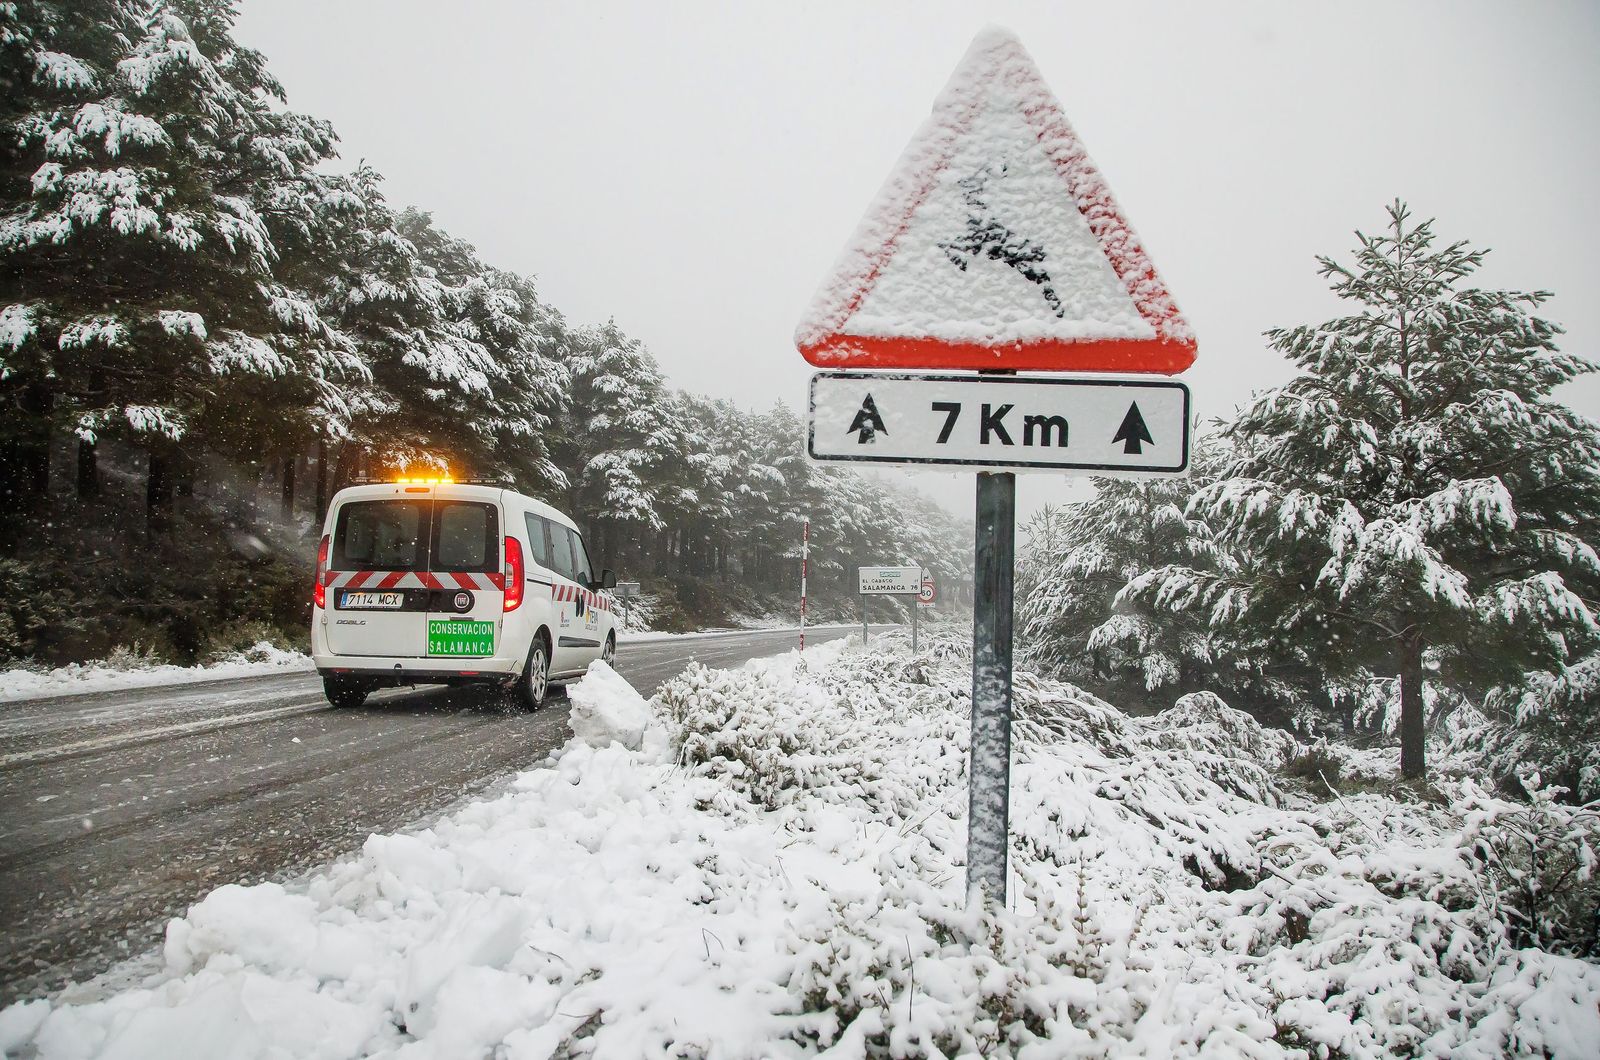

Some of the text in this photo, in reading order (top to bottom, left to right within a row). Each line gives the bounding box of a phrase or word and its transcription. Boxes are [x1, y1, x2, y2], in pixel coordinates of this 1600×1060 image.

[931, 401, 1069, 448] 7 Km
[348, 594, 399, 605] 7114 MCX
[430, 622, 493, 635] CONSERVACION
[429, 641, 493, 653] SALAMANCA
